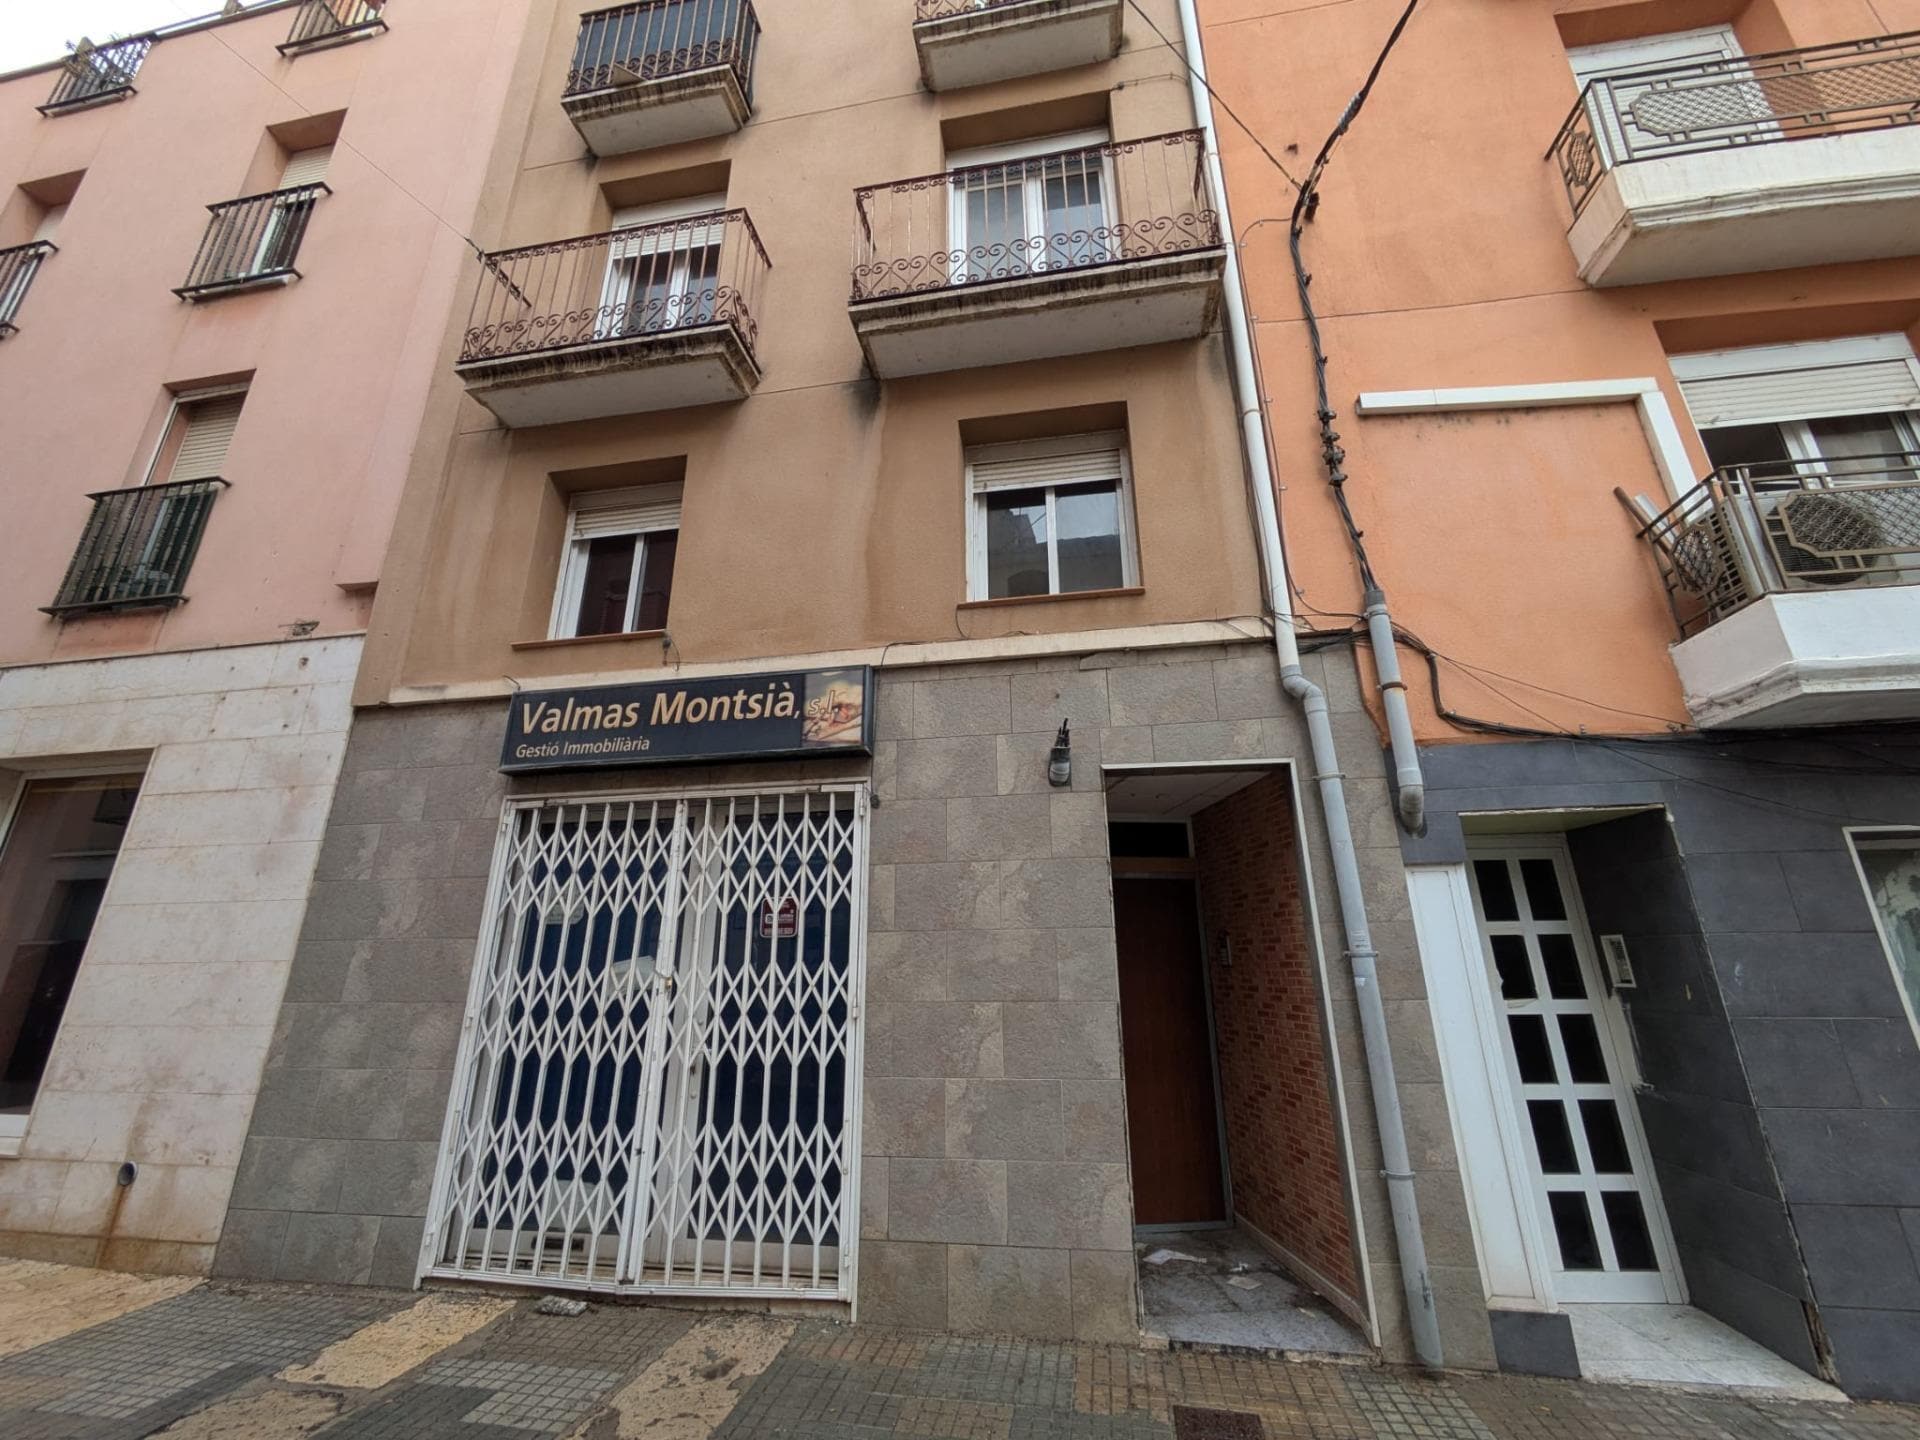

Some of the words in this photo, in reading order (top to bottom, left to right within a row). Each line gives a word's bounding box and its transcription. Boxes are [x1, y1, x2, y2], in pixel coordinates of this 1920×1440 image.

[523, 697, 640, 734] Valmas
[650, 681, 800, 726] Montsià,
[807, 689, 839, 716] s.l.
[516, 741, 559, 758] Gestió
[563, 736, 650, 755] Immobiliària
